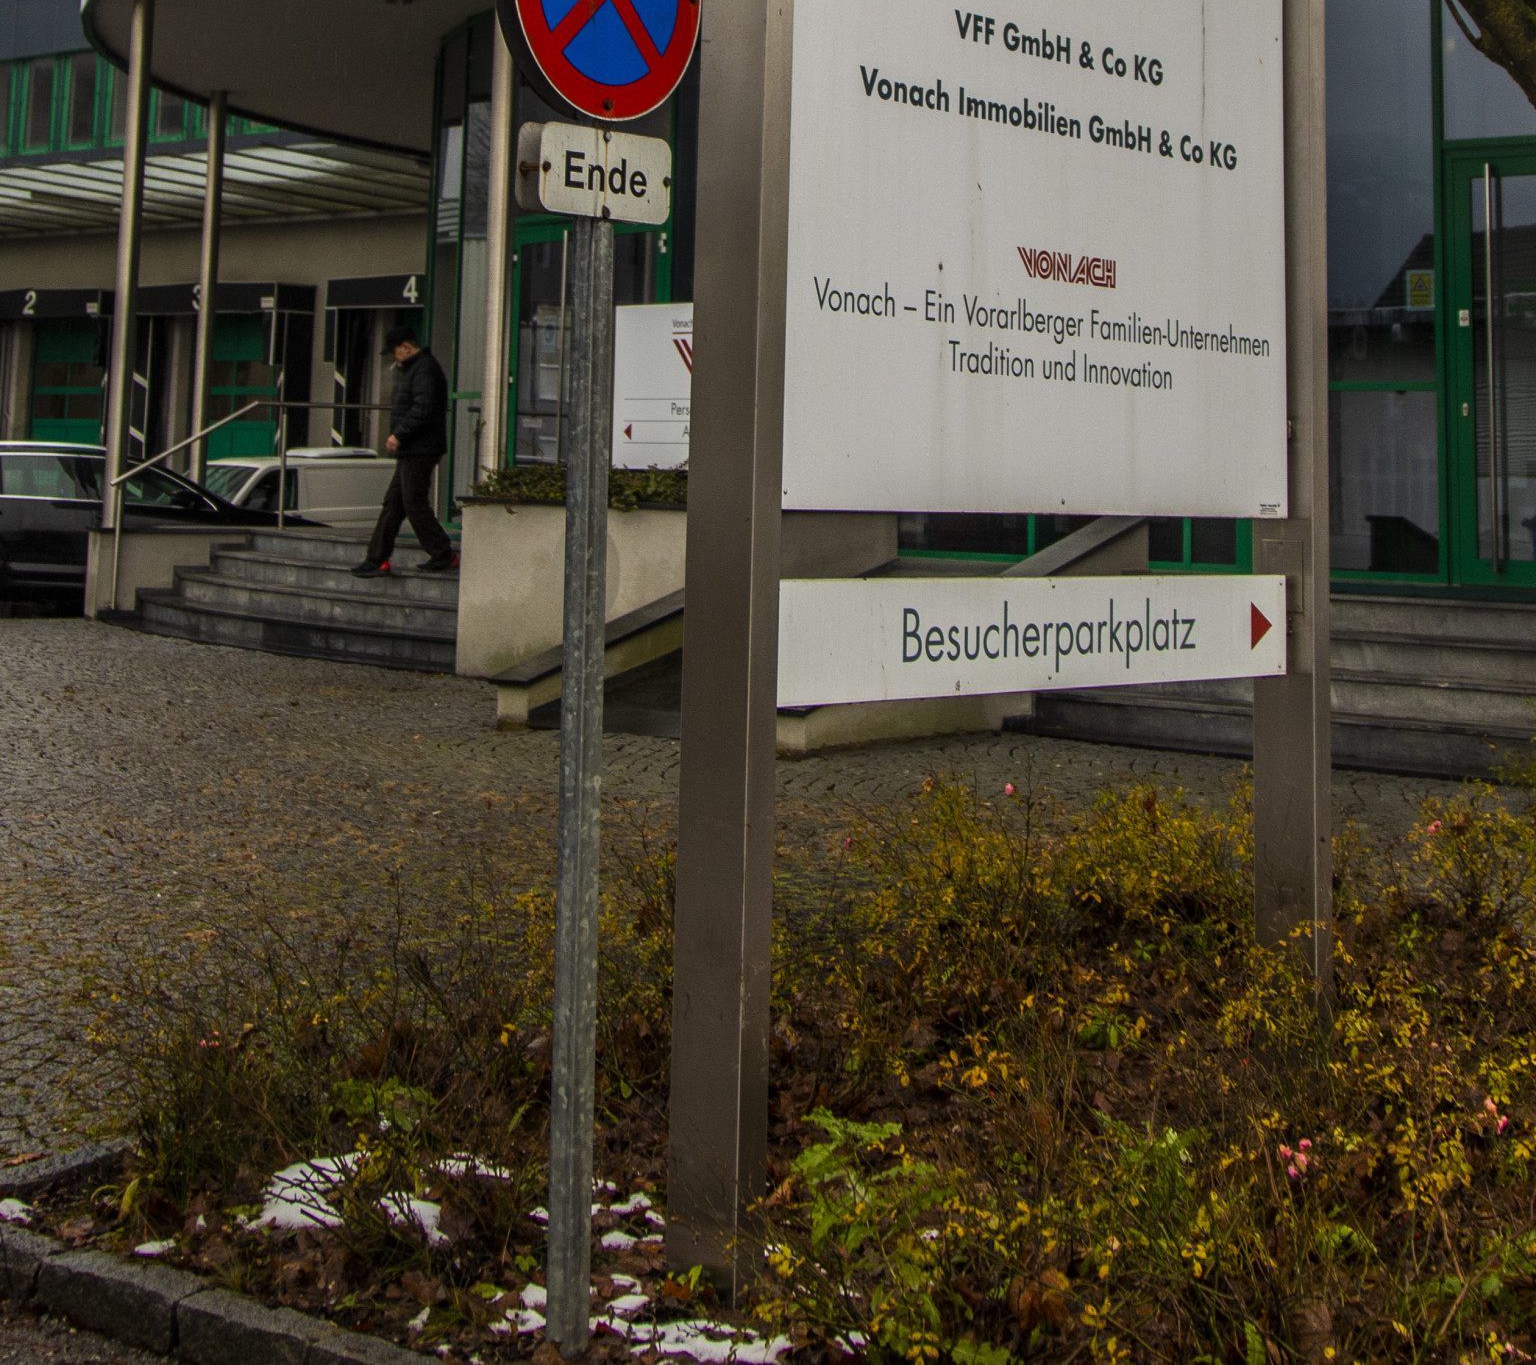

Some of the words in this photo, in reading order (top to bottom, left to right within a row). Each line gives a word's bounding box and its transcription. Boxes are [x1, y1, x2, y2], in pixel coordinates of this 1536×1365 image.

[954, 9, 996, 46] VFF
[1002, 21, 1071, 65] GmbH
[1078, 40, 1095, 71] &
[1101, 46, 1127, 78] Co
[1134, 54, 1164, 87] KG
[859, 64, 950, 113] Vonach
[958, 86, 1081, 140] Immobilien
[1088, 114, 1152, 154] GmbH
[1158, 129, 1174, 159] &
[1179, 134, 1204, 164] Co
[1209, 140, 1238, 171] KG
[564, 149, 648, 199] Ende
[402, 275, 418, 304] 4
[1016, 246, 1117, 289] VONACH
[22, 290, 37, 316] 2
[813, 276, 896, 318] Vonach
[925, 289, 955, 324] Ein
[962, 294, 1084, 345] Vorarlberger
[1090, 309, 1270, 357] Familien-Unternehmen
[948, 339, 1035, 378] Tradition
[1042, 349, 1076, 382] und
[1083, 353, 1173, 390] Innovation
[902, 597, 1196, 674] Besucherparkplatz
